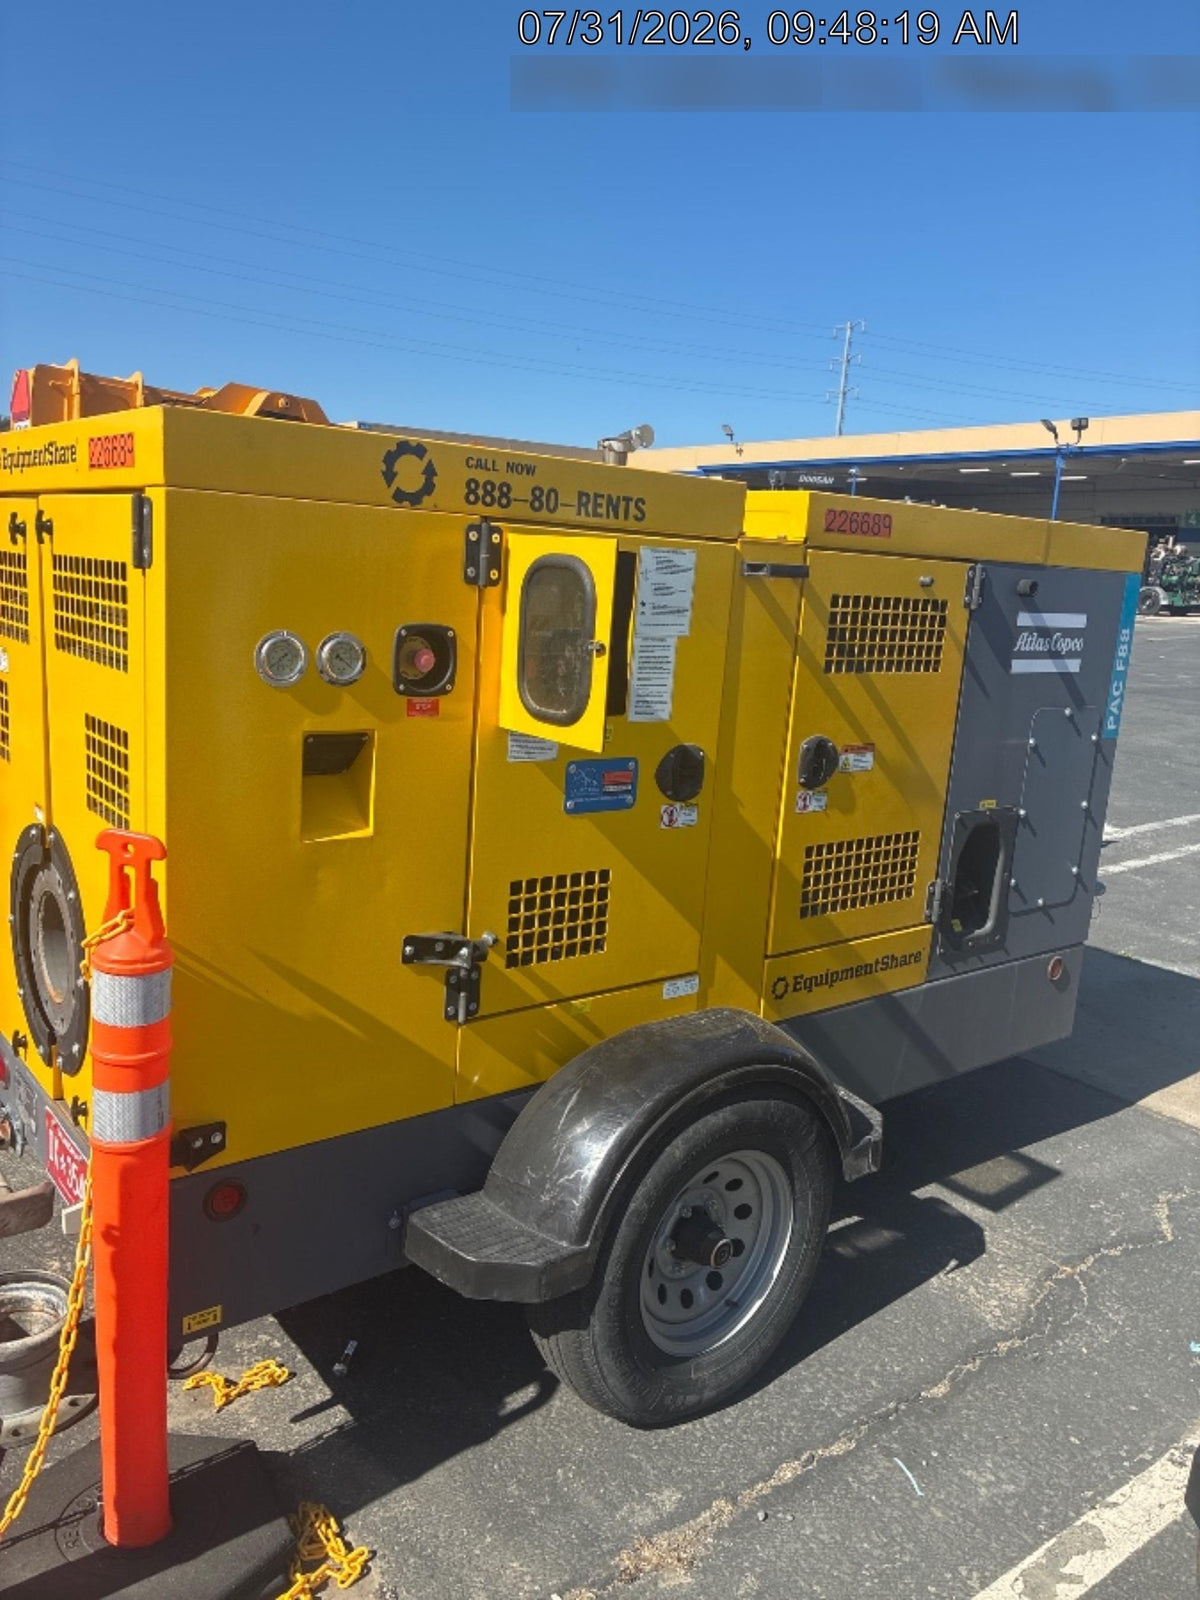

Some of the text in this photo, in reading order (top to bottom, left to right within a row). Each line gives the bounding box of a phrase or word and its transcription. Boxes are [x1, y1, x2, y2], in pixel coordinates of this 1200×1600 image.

[2, 440, 77, 475] EquipmentShare
[465, 456, 537, 476] CALL NOW
[463, 477, 646, 522] 888-80-RENTS
[824, 508, 893, 537] 226689
[1013, 632, 1084, 655] Atlas Copco
[1107, 680, 1123, 730] PAC
[792, 948, 923, 993] EquipmentShare
